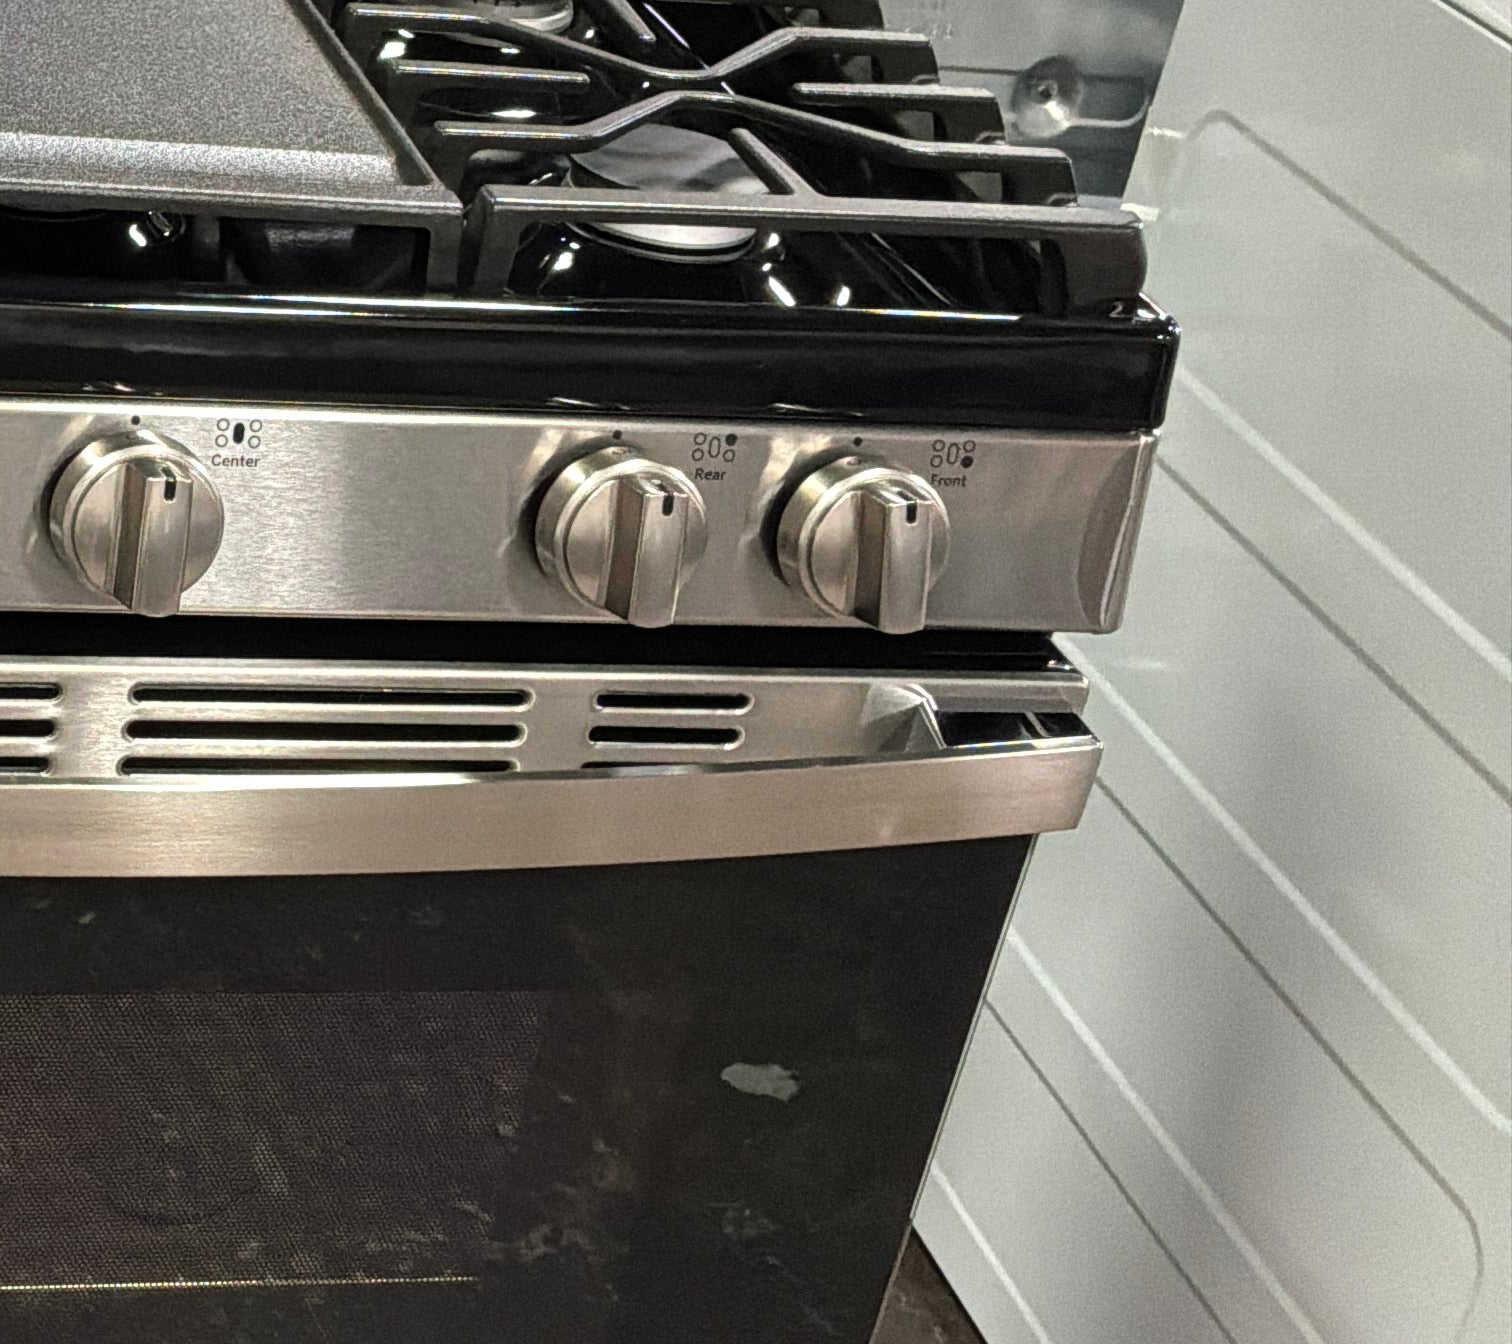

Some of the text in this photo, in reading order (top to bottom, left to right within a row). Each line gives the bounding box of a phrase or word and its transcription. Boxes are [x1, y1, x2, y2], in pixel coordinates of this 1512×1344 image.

[211, 453, 261, 467] Center
[694, 467, 727, 481] Rear
[931, 473, 967, 488] Front
